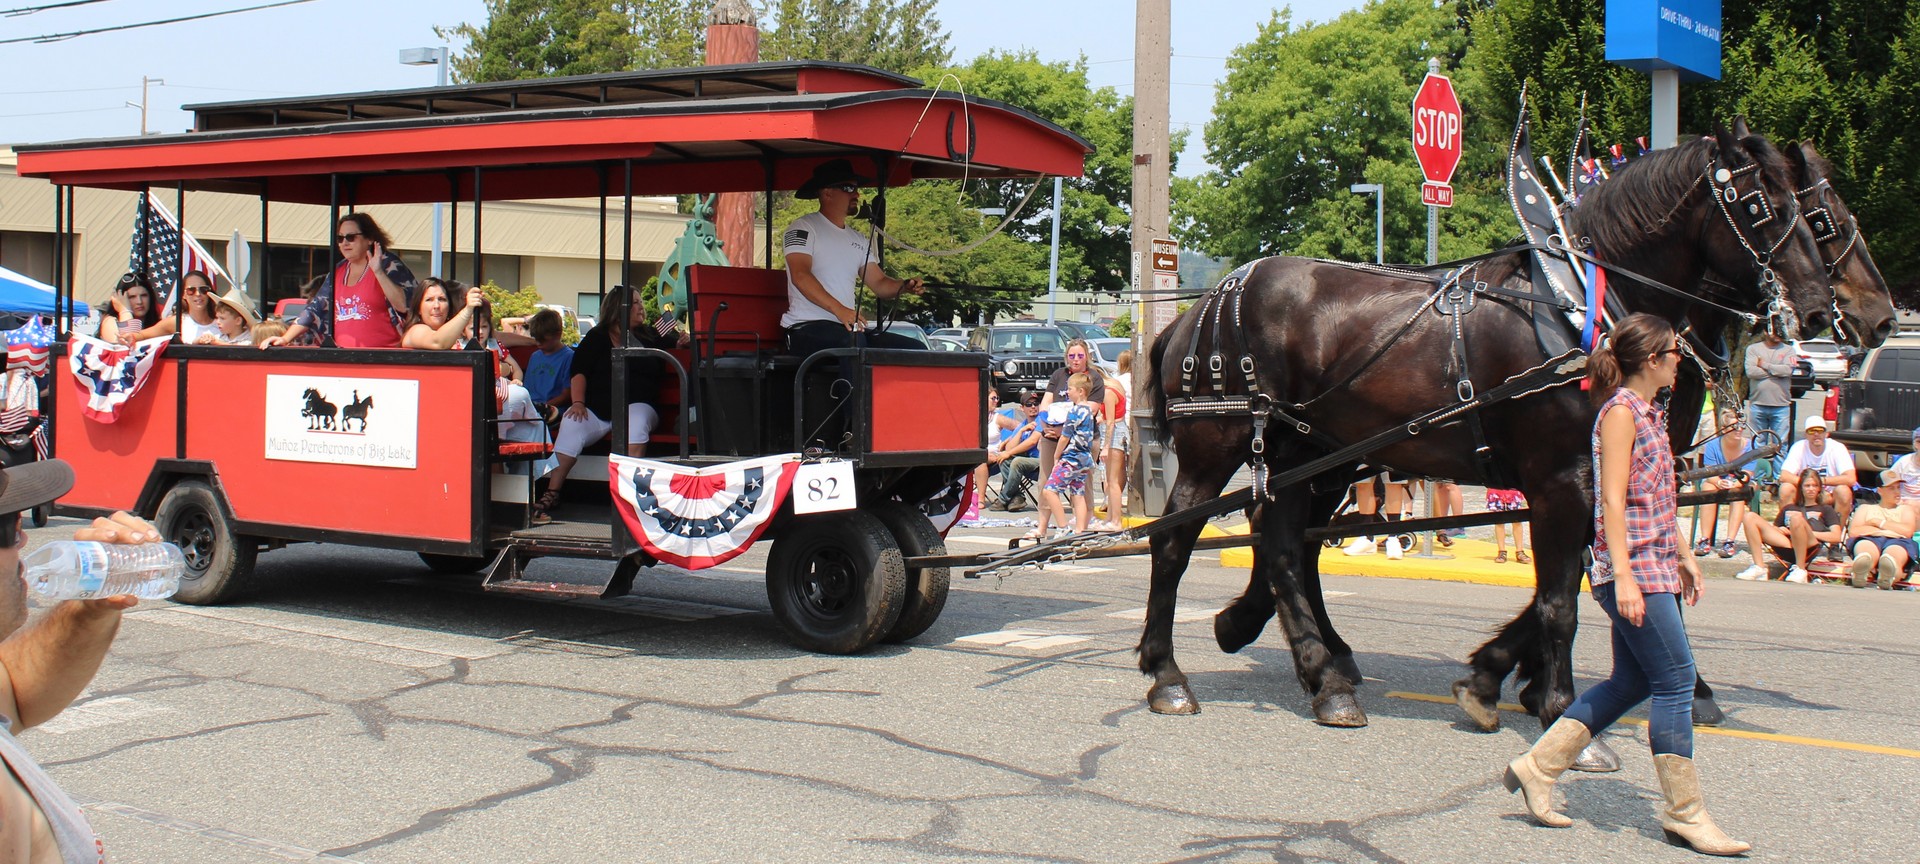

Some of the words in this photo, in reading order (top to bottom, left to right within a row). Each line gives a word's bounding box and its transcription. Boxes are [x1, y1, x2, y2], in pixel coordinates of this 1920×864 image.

[1660, 6, 1692, 30] DRIVE-THRU
[1694, 21, 1702, 34] 24
[1701, 24, 1710, 38] HR
[1708, 28, 1720, 41] ATM
[1416, 106, 1459, 151] STOP
[1424, 187, 1436, 201] ALL
[1437, 189, 1451, 203] WAY
[1153, 242, 1178, 255] MUSEUM
[1161, 278, 1170, 288] NO
[268, 437, 299, 452] Muñoz
[301, 439, 355, 456] Percherons
[356, 443, 367, 461] of
[368, 443, 386, 462] Big
[387, 444, 411, 461] Lake
[807, 476, 841, 502] 82
